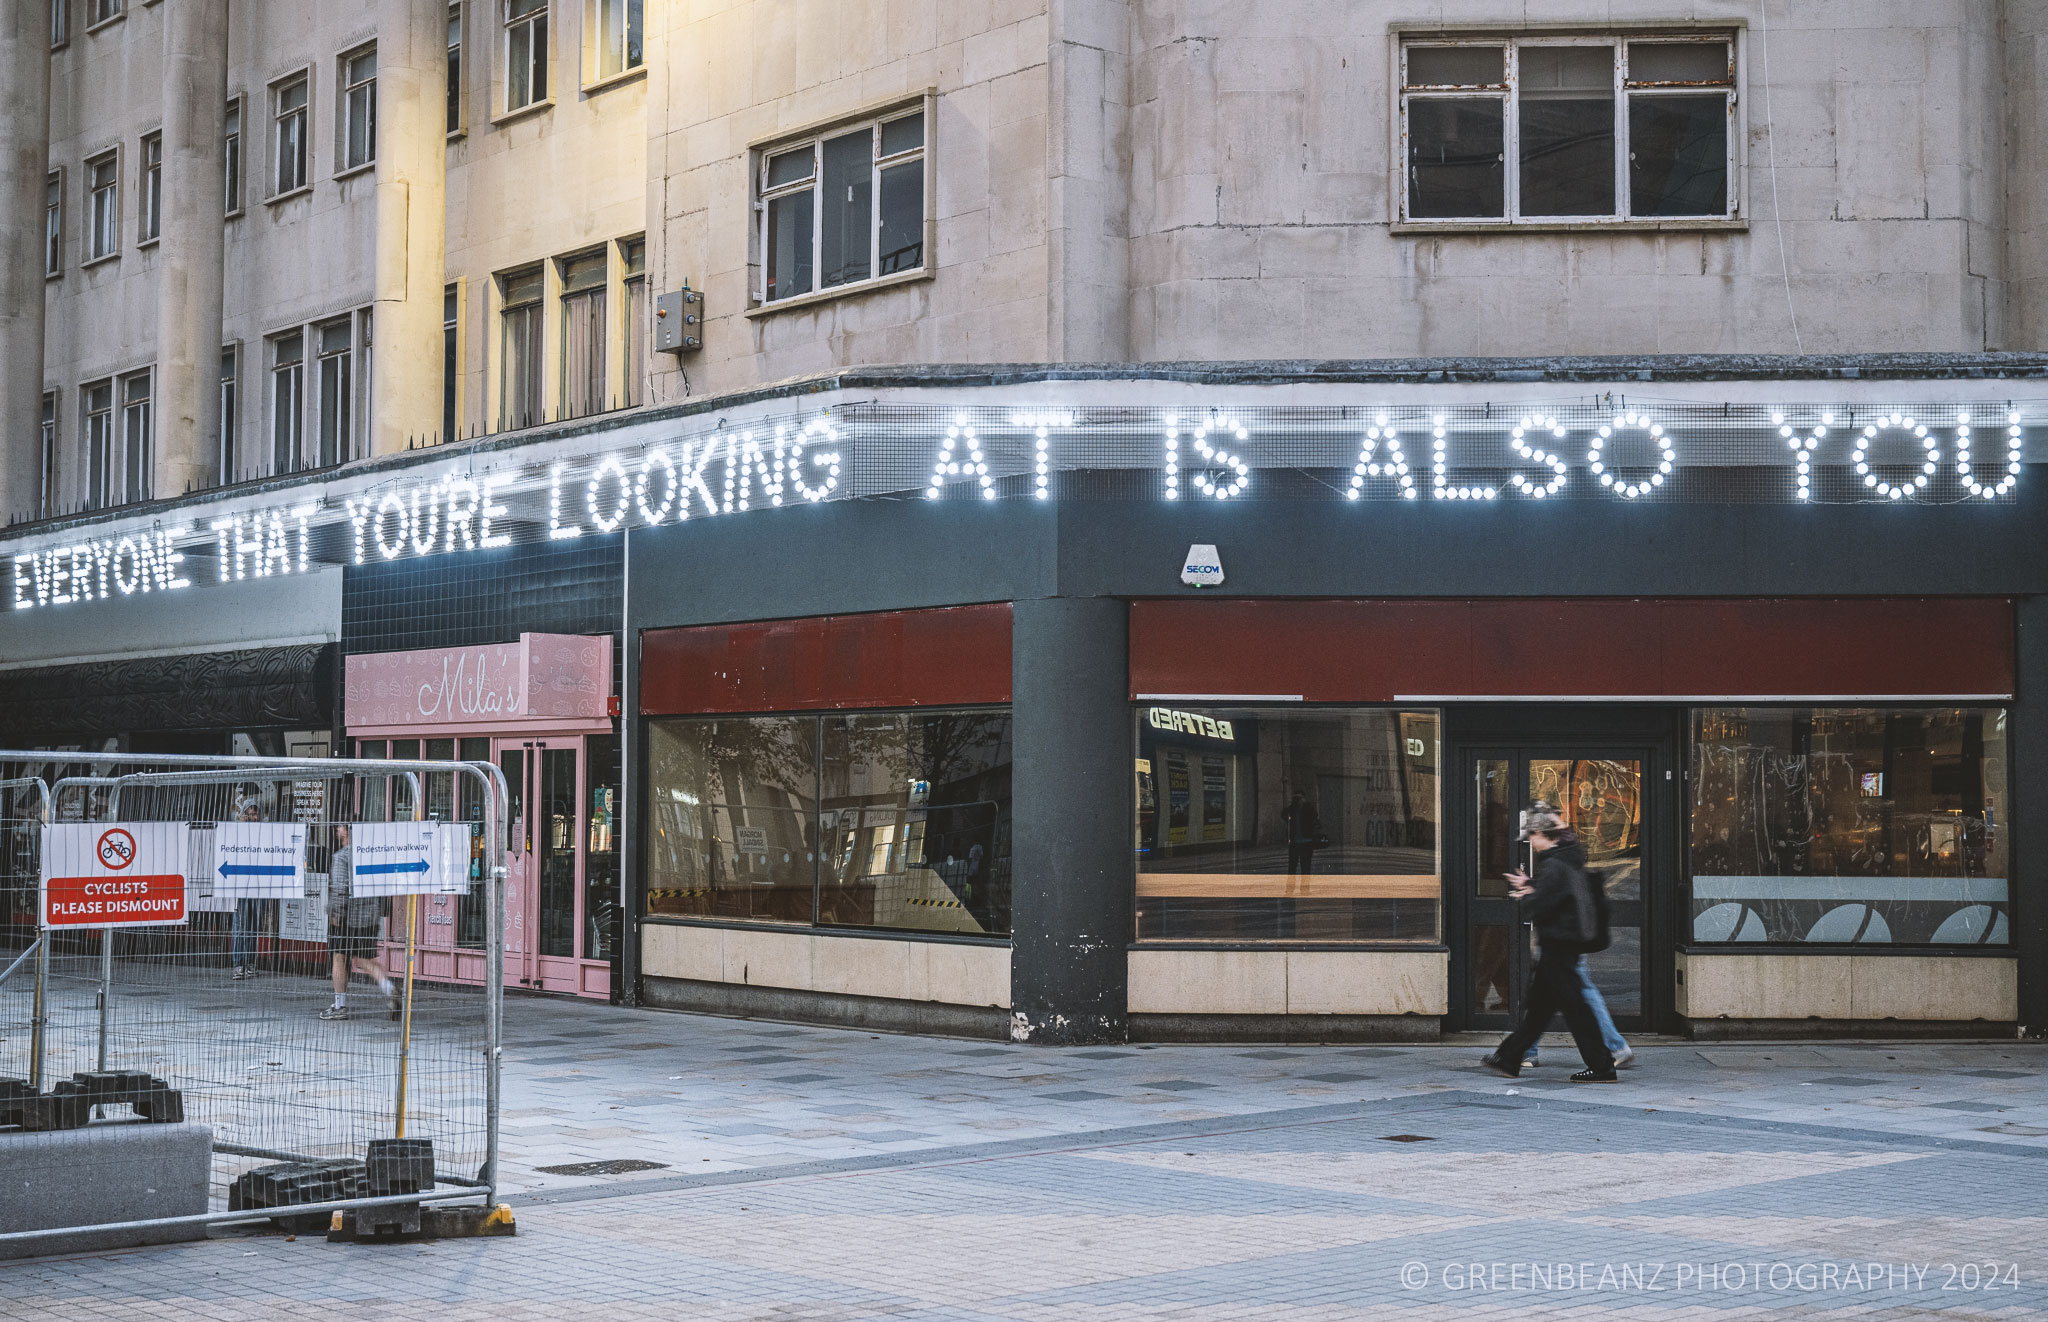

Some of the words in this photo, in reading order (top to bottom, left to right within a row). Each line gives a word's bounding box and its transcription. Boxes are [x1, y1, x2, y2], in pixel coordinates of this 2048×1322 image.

[15, 534, 190, 606] EVERYONE
[211, 505, 317, 582] THAT
[549, 419, 841, 538] LOOKING
[926, 414, 1073, 500] AT
[1165, 414, 1249, 500] IS
[1347, 412, 1676, 500] ALSO
[1771, 412, 2022, 500] YOU
[1186, 565, 1219, 573] SECOM
[418, 652, 520, 716] Mila's
[221, 845, 261, 853] Pedestrian
[264, 846, 296, 855] walkway
[356, 845, 395, 853] Pedestrian
[397, 844, 429, 852] walkway
[84, 882, 148, 895] CYCLISTS
[52, 901, 103, 915] PLEASE
[106, 899, 179, 913] DISMOUNT
